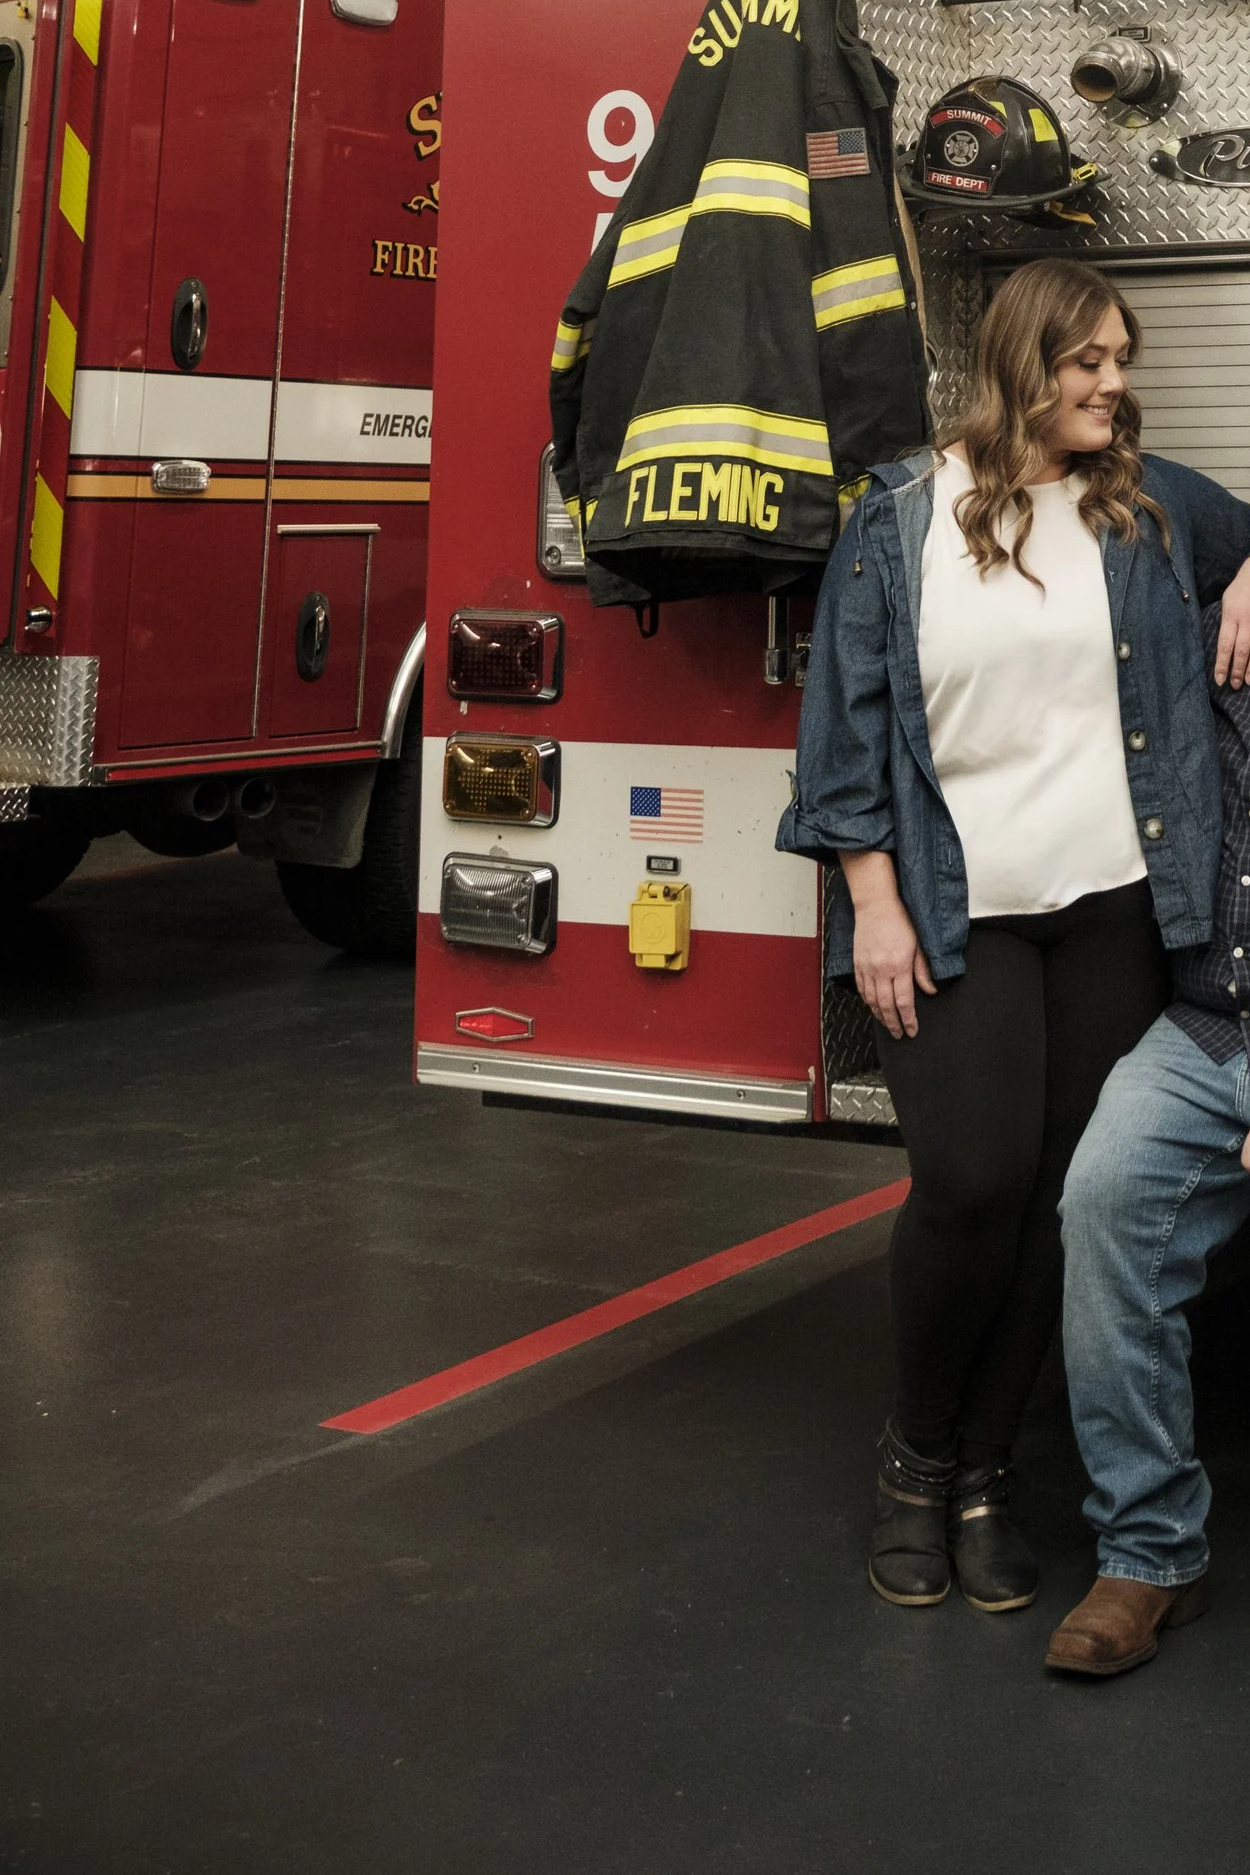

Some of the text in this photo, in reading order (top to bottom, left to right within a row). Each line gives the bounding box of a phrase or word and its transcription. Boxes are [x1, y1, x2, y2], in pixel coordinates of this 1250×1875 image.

[408, 91, 442, 159] S
[946, 109, 992, 125] SUMMIT
[931, 172, 984, 190] FIRE DEPT
[359, 412, 432, 438] EMERG
[625, 462, 784, 531] FLEMING
